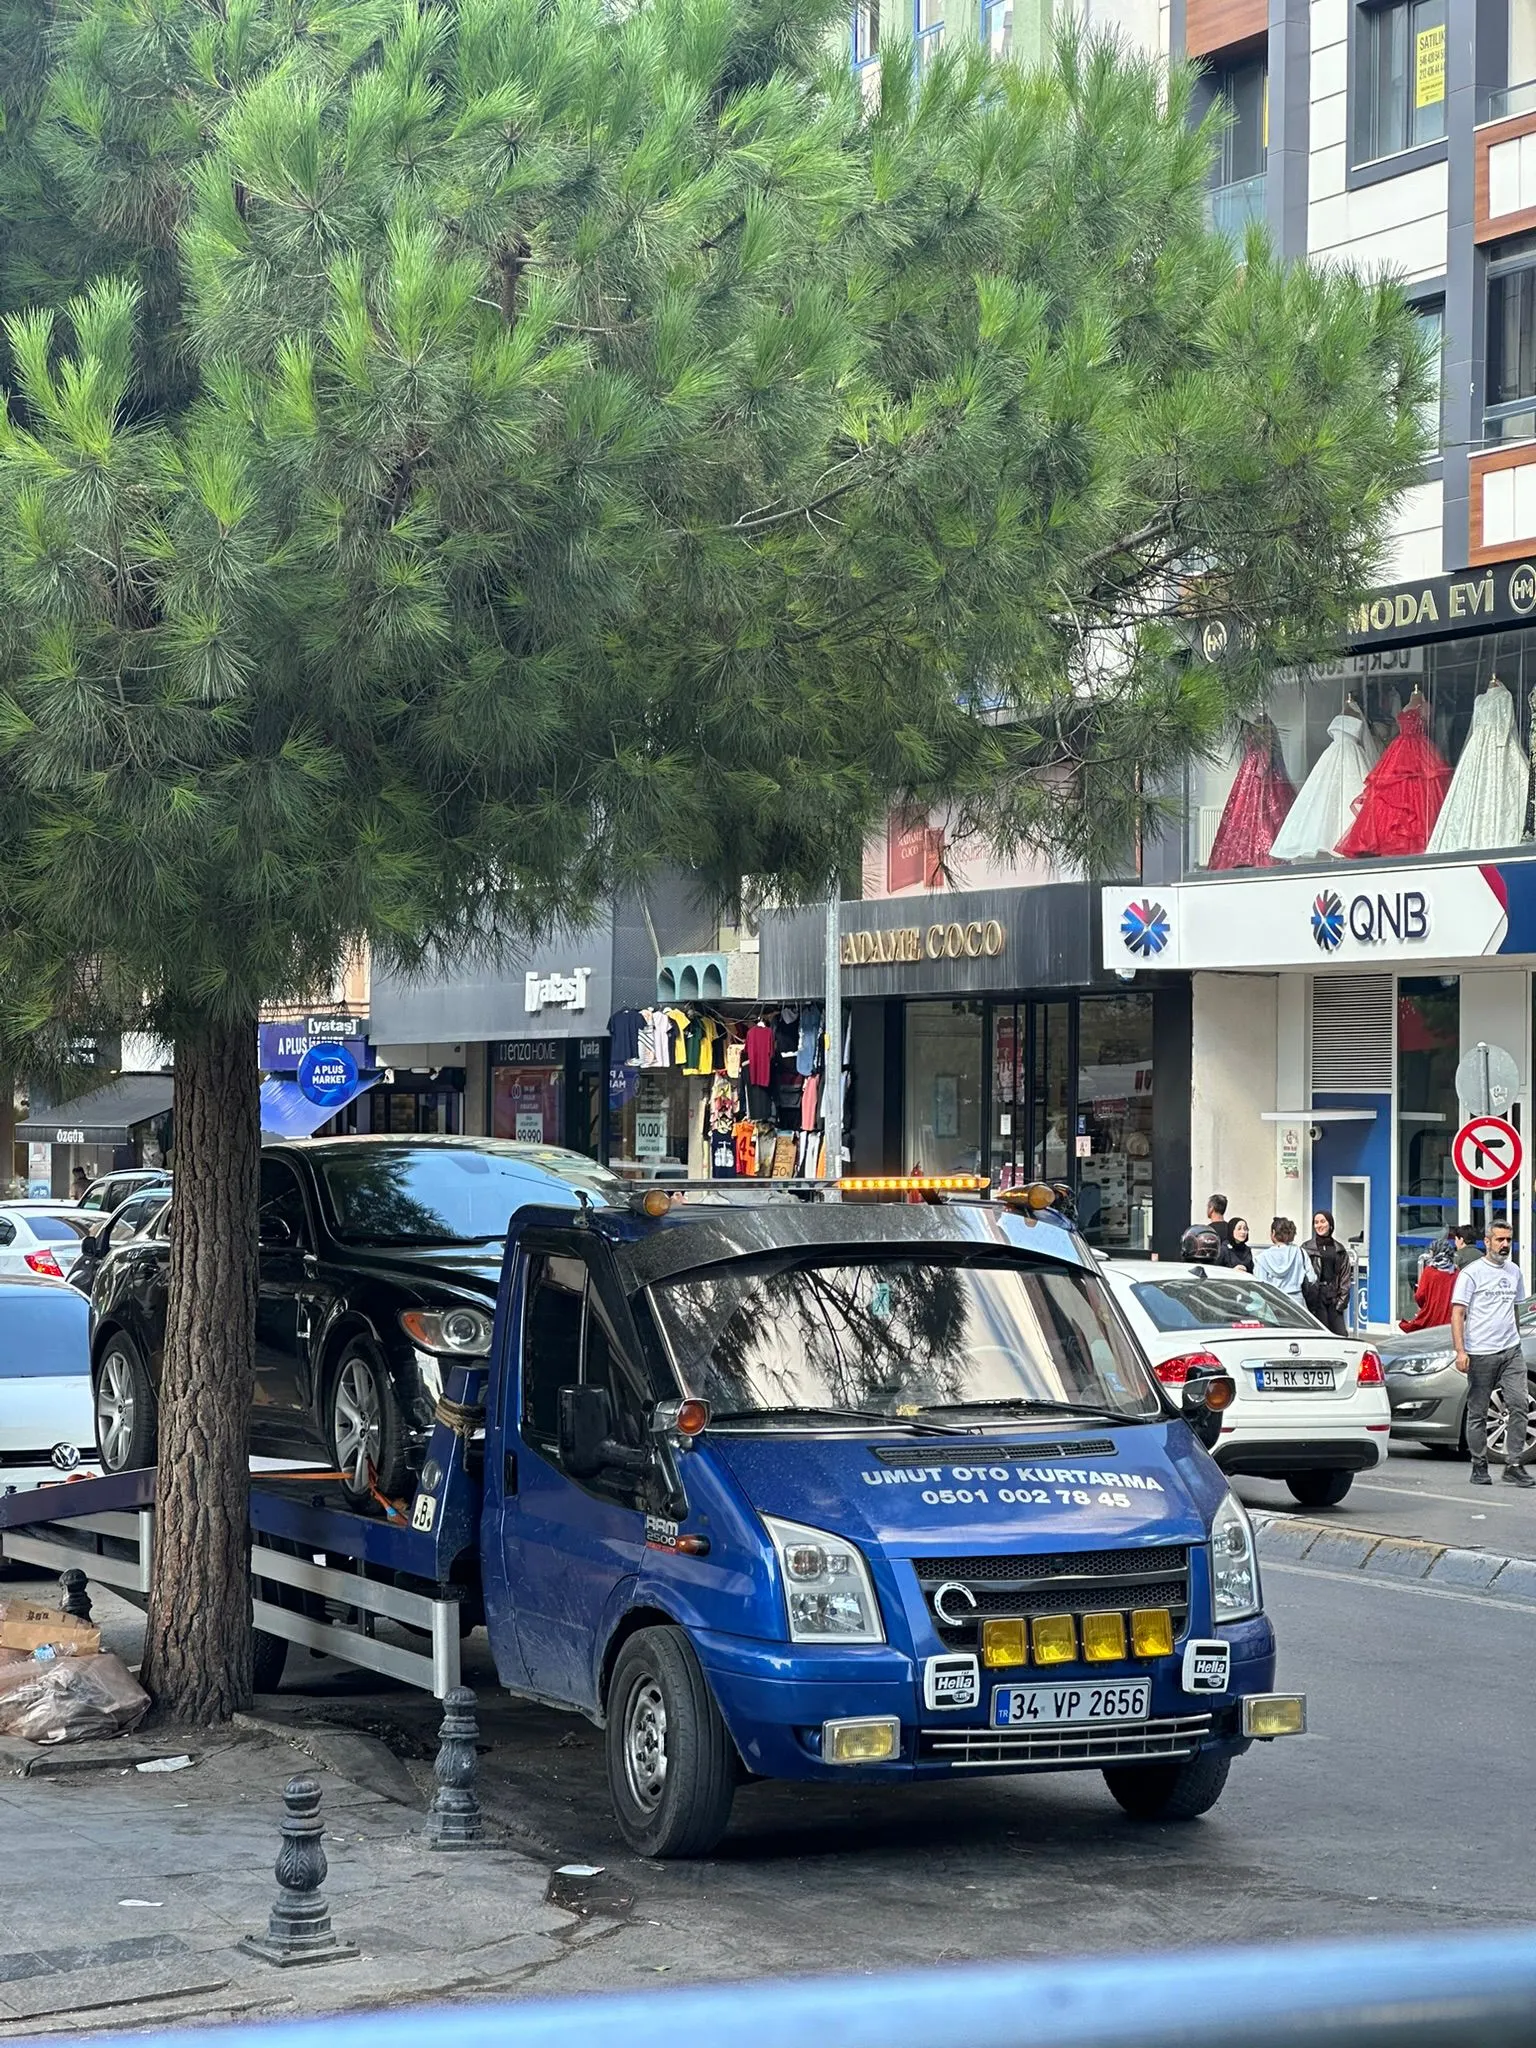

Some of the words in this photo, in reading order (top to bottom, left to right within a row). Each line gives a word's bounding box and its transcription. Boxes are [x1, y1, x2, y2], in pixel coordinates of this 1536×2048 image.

[1450, 570, 1494, 617] EVİ
[1350, 891, 1428, 941] QNB
[840, 928, 920, 965] ADAME
[926, 920, 1004, 959] COCO
[278, 1038, 284, 1055] A
[285, 1037, 307, 1055] PLUS
[314, 1066, 321, 1074] A
[322, 1065, 344, 1074] PLUS
[312, 1075, 346, 1084] MARKET
[1264, 1371, 1278, 1386] 34
[1283, 1371, 1297, 1386] RK
[1302, 1371, 1331, 1386] 9797
[861, 1467, 942, 1486] UMUT
[952, 1467, 1010, 1482] OTO
[1016, 1467, 1165, 1492] KURTARMA
[921, 1488, 990, 1505] 0501
[998, 1488, 1051, 1504] 002
[1055, 1489, 1092, 1505] 78
[1097, 1491, 1132, 1508] 45
[646, 1530, 676, 1547] 2500
[1196, 1660, 1225, 1673] Hella
[937, 1676, 973, 1690] Hella
[999, 1710, 1009, 1718] TR
[1012, 1693, 1039, 1720] 34
[1054, 1691, 1081, 1718] VP
[1089, 1688, 1145, 1716] 2656
